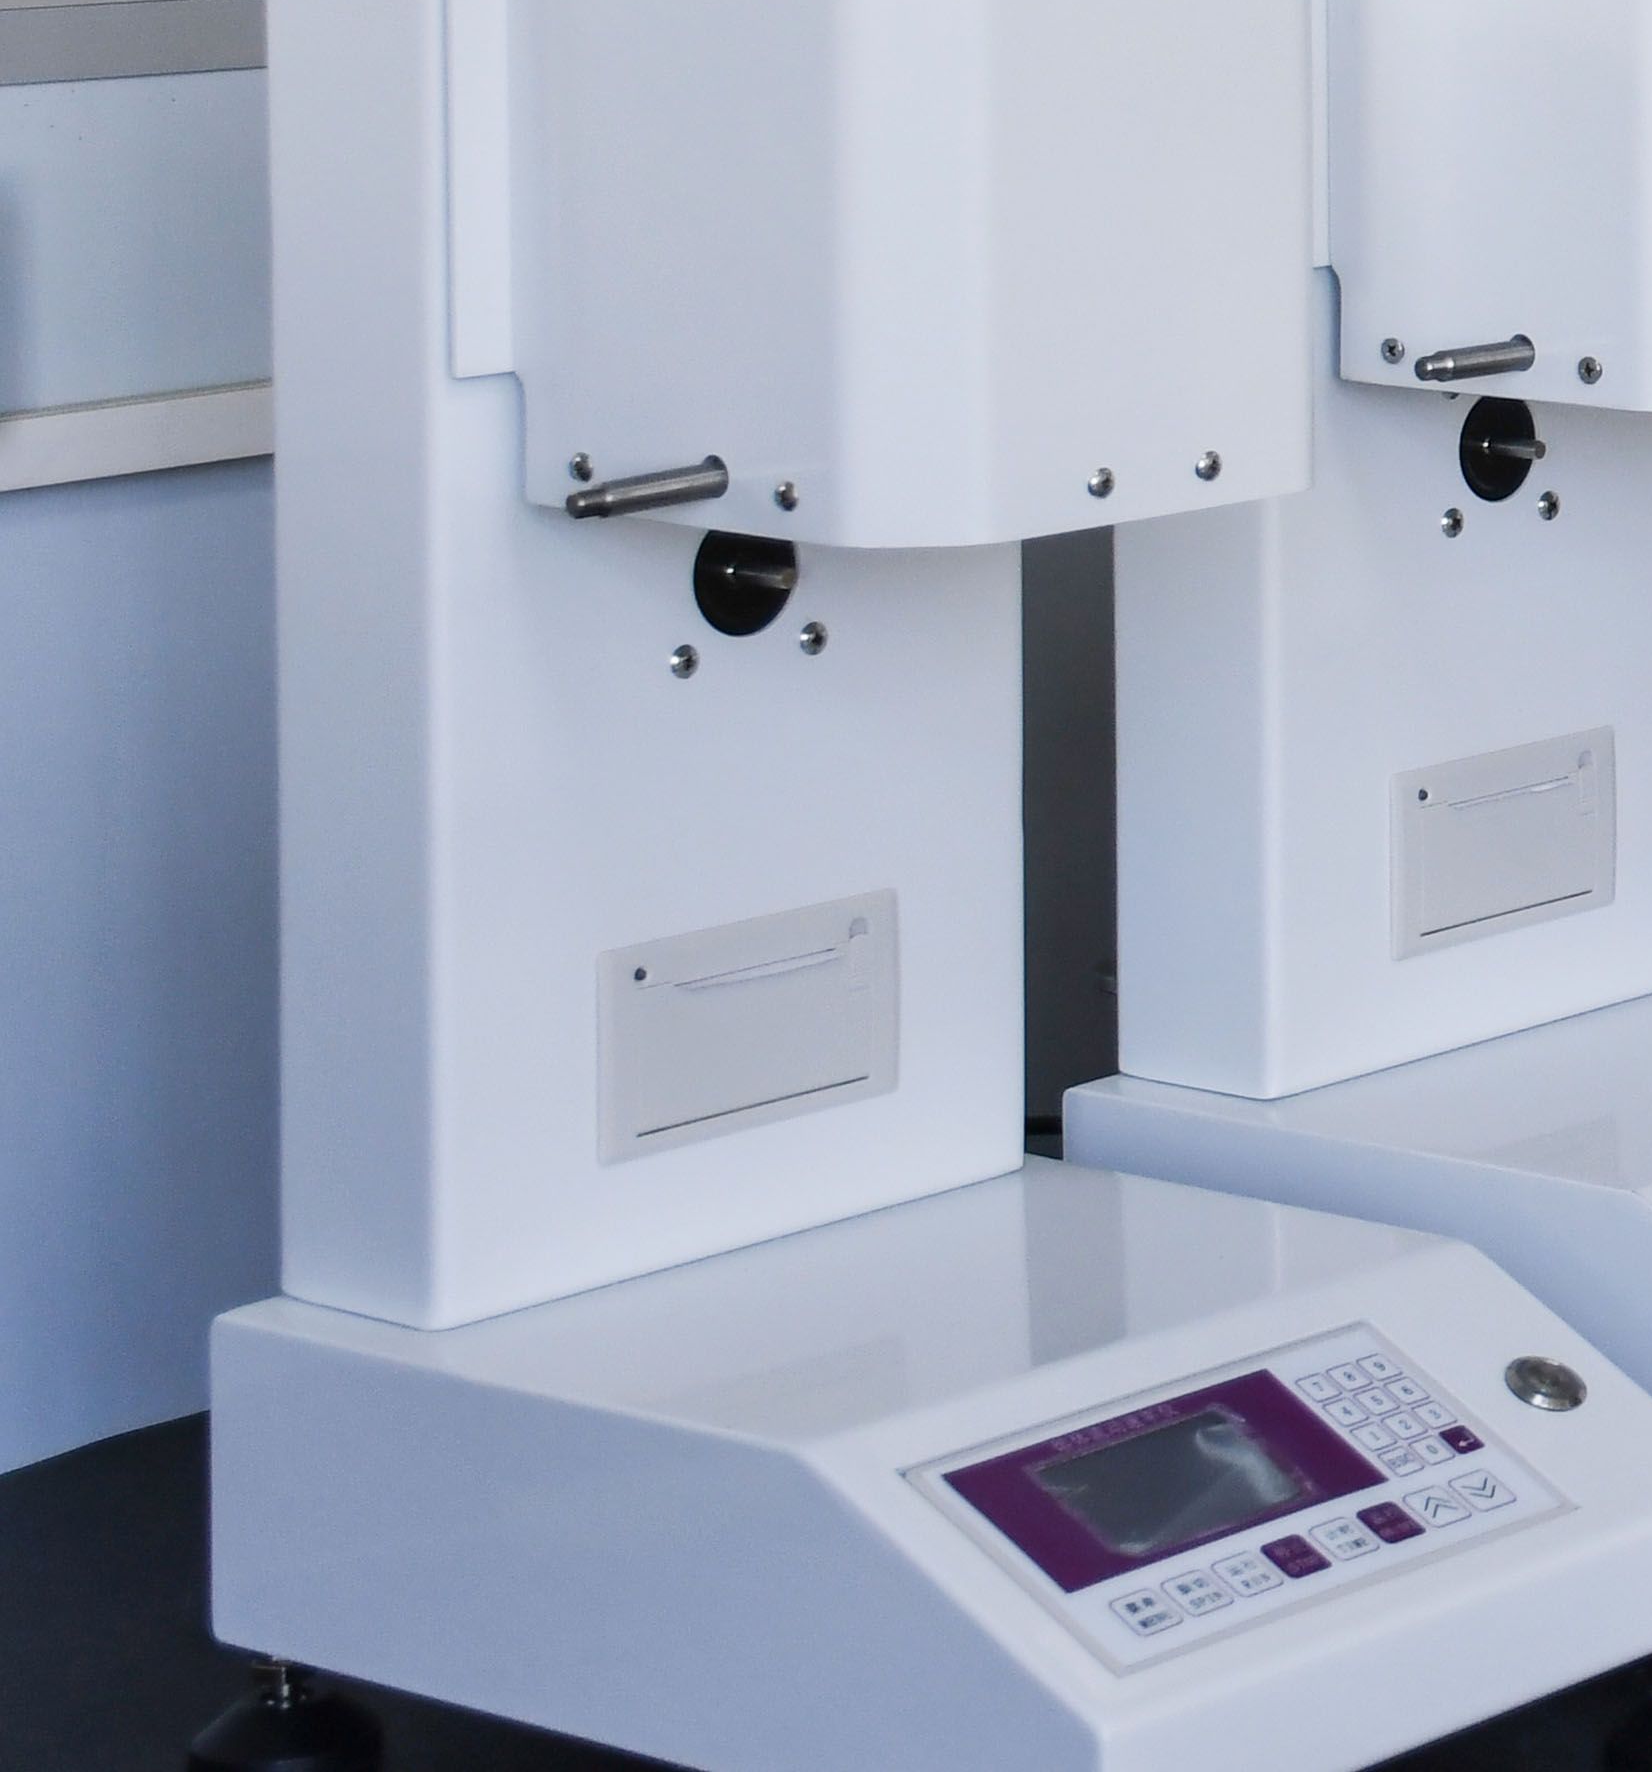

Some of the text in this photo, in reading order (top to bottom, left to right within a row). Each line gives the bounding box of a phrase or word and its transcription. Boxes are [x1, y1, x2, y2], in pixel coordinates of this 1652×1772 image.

[1312, 1381, 1324, 1392] 7
[1341, 1406, 1353, 1416] 4
[1371, 1395, 1383, 1406] 5
[1369, 1432, 1380, 1441] 1
[1398, 1419, 1411, 1430] 2
[1426, 1444, 1438, 1455] 0
